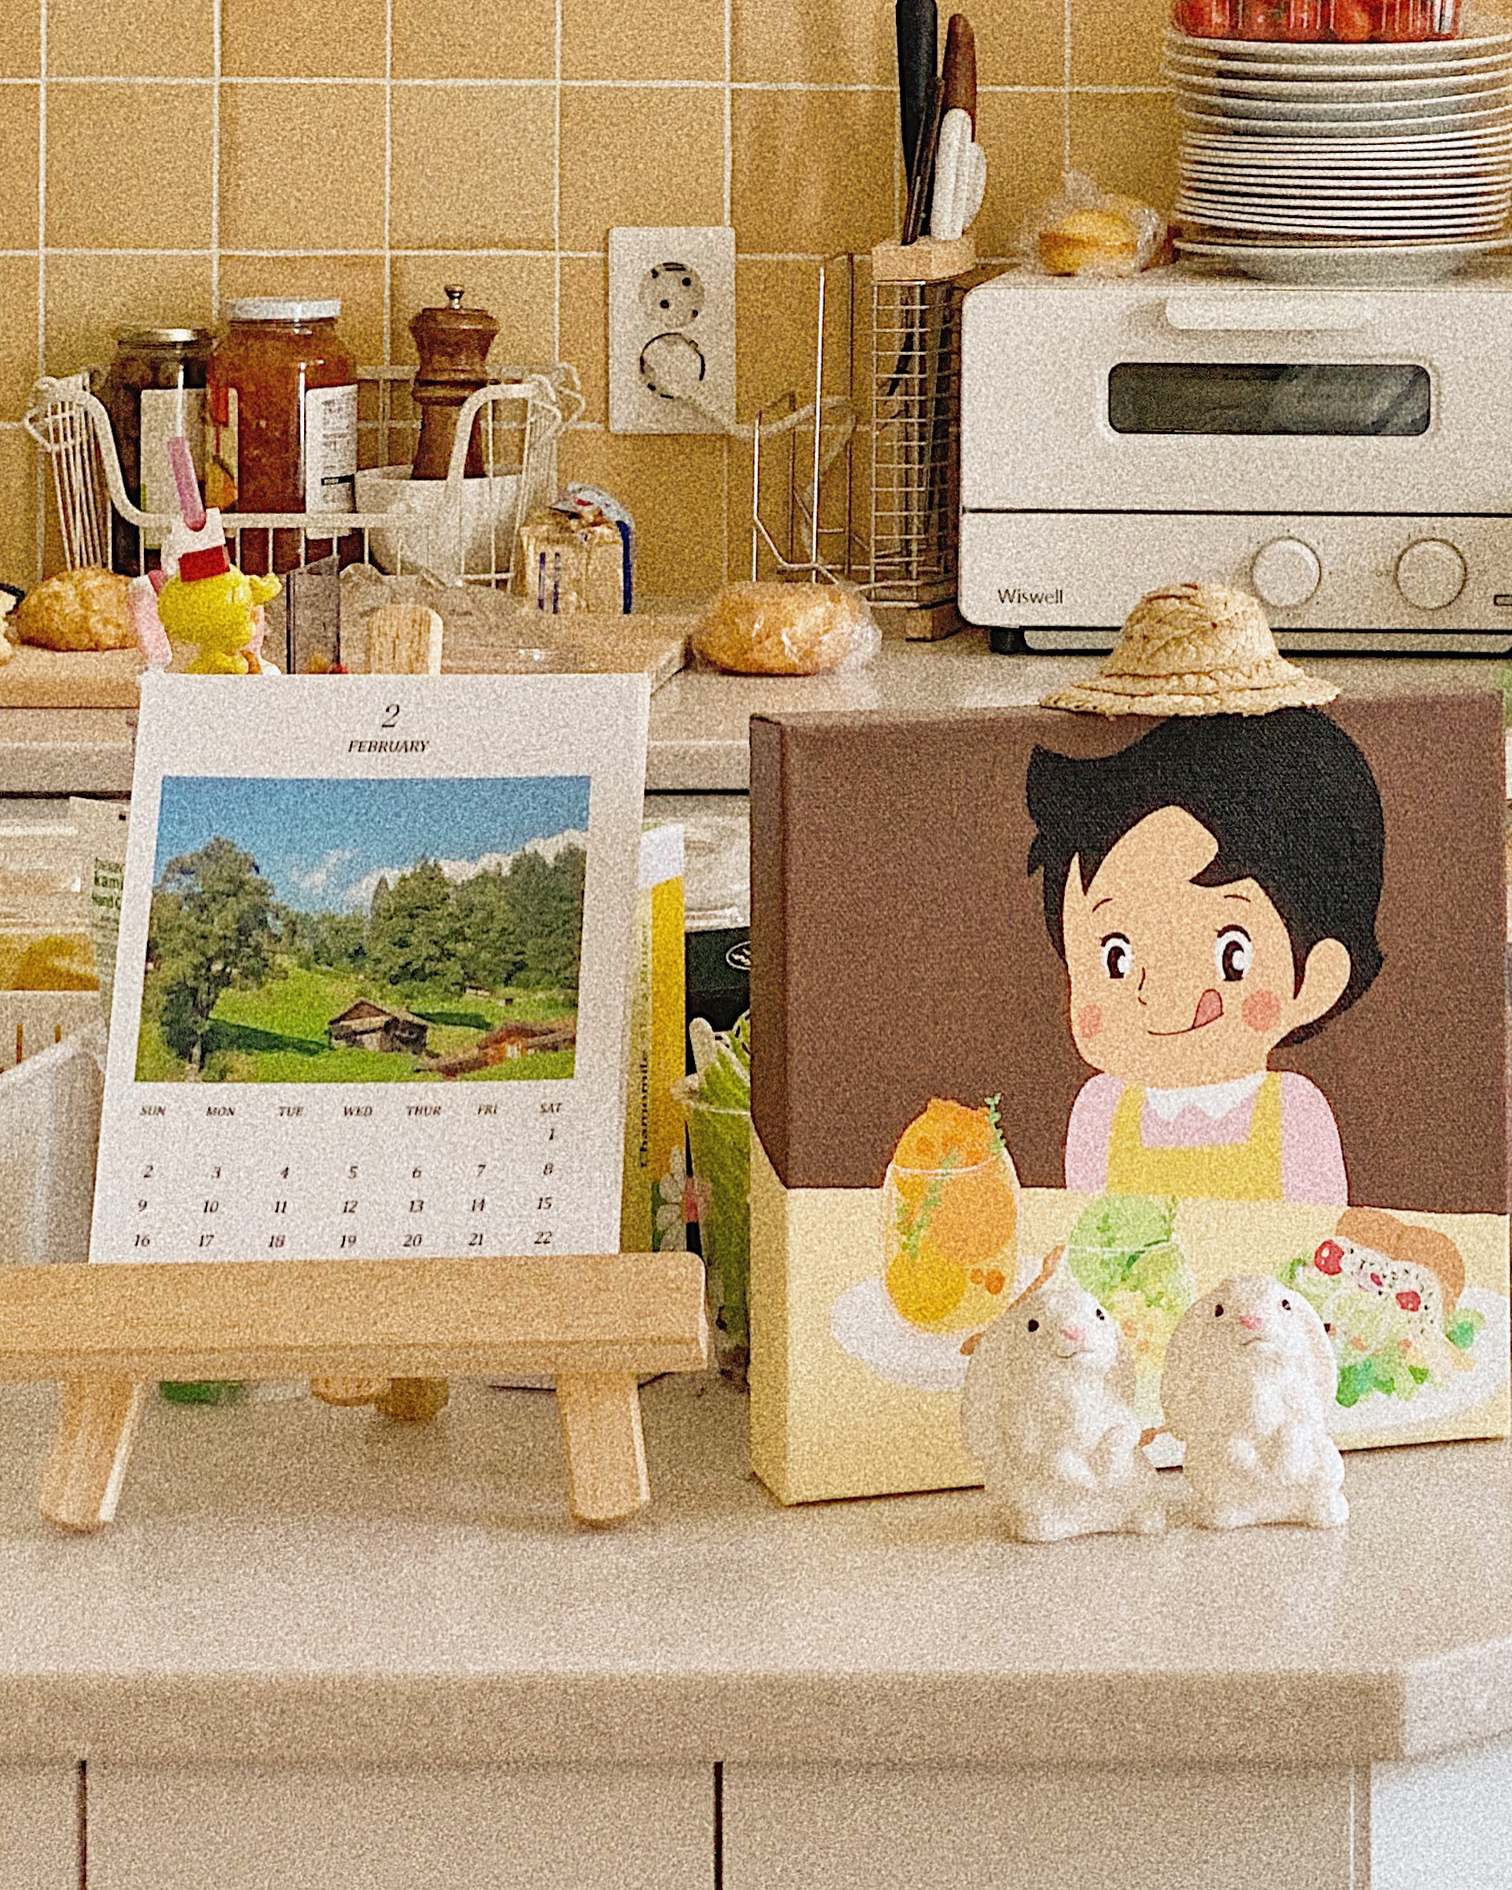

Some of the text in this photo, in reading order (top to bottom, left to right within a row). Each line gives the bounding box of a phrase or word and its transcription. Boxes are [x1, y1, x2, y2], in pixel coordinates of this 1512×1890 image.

[997, 588, 1063, 604] Wiswell
[381, 704, 401, 729] 2
[348, 740, 430, 754] FEBRUARY
[140, 1102, 563, 1117] SUN MON TUE WED THUR FRI SAT
[548, 1128, 555, 1141] 1
[143, 1162, 554, 1180] 2 3 4 5 6 7 8
[137, 1196, 553, 1214] 9 10 11 12 13 14 15
[134, 1230, 553, 1248] 16 17 18 19 20 21 22
